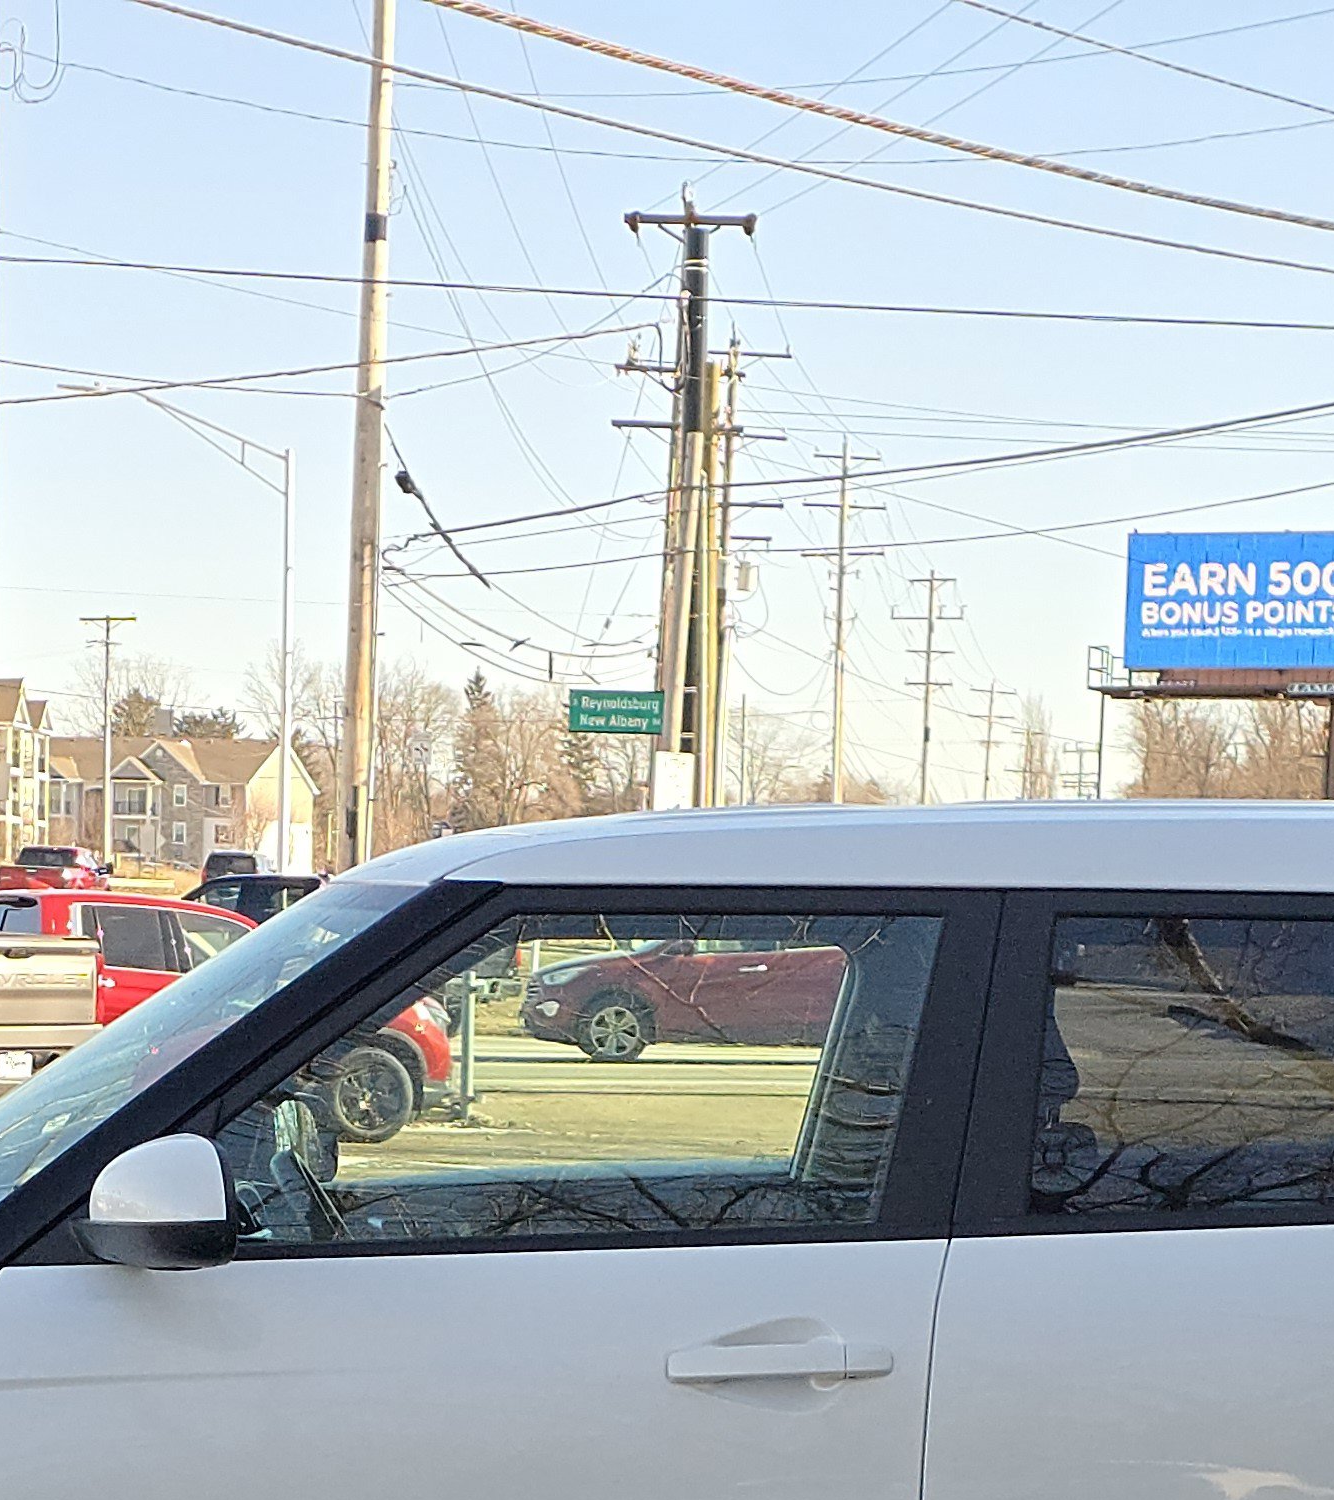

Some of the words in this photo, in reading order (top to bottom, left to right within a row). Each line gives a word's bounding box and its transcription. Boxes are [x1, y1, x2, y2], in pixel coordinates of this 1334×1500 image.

[1143, 562, 1256, 597] EARN
[1141, 601, 1239, 625] BONUS
[581, 696, 659, 714] Reynoldsburg
[579, 714, 606, 726] New
[608, 714, 648, 731] Albany
